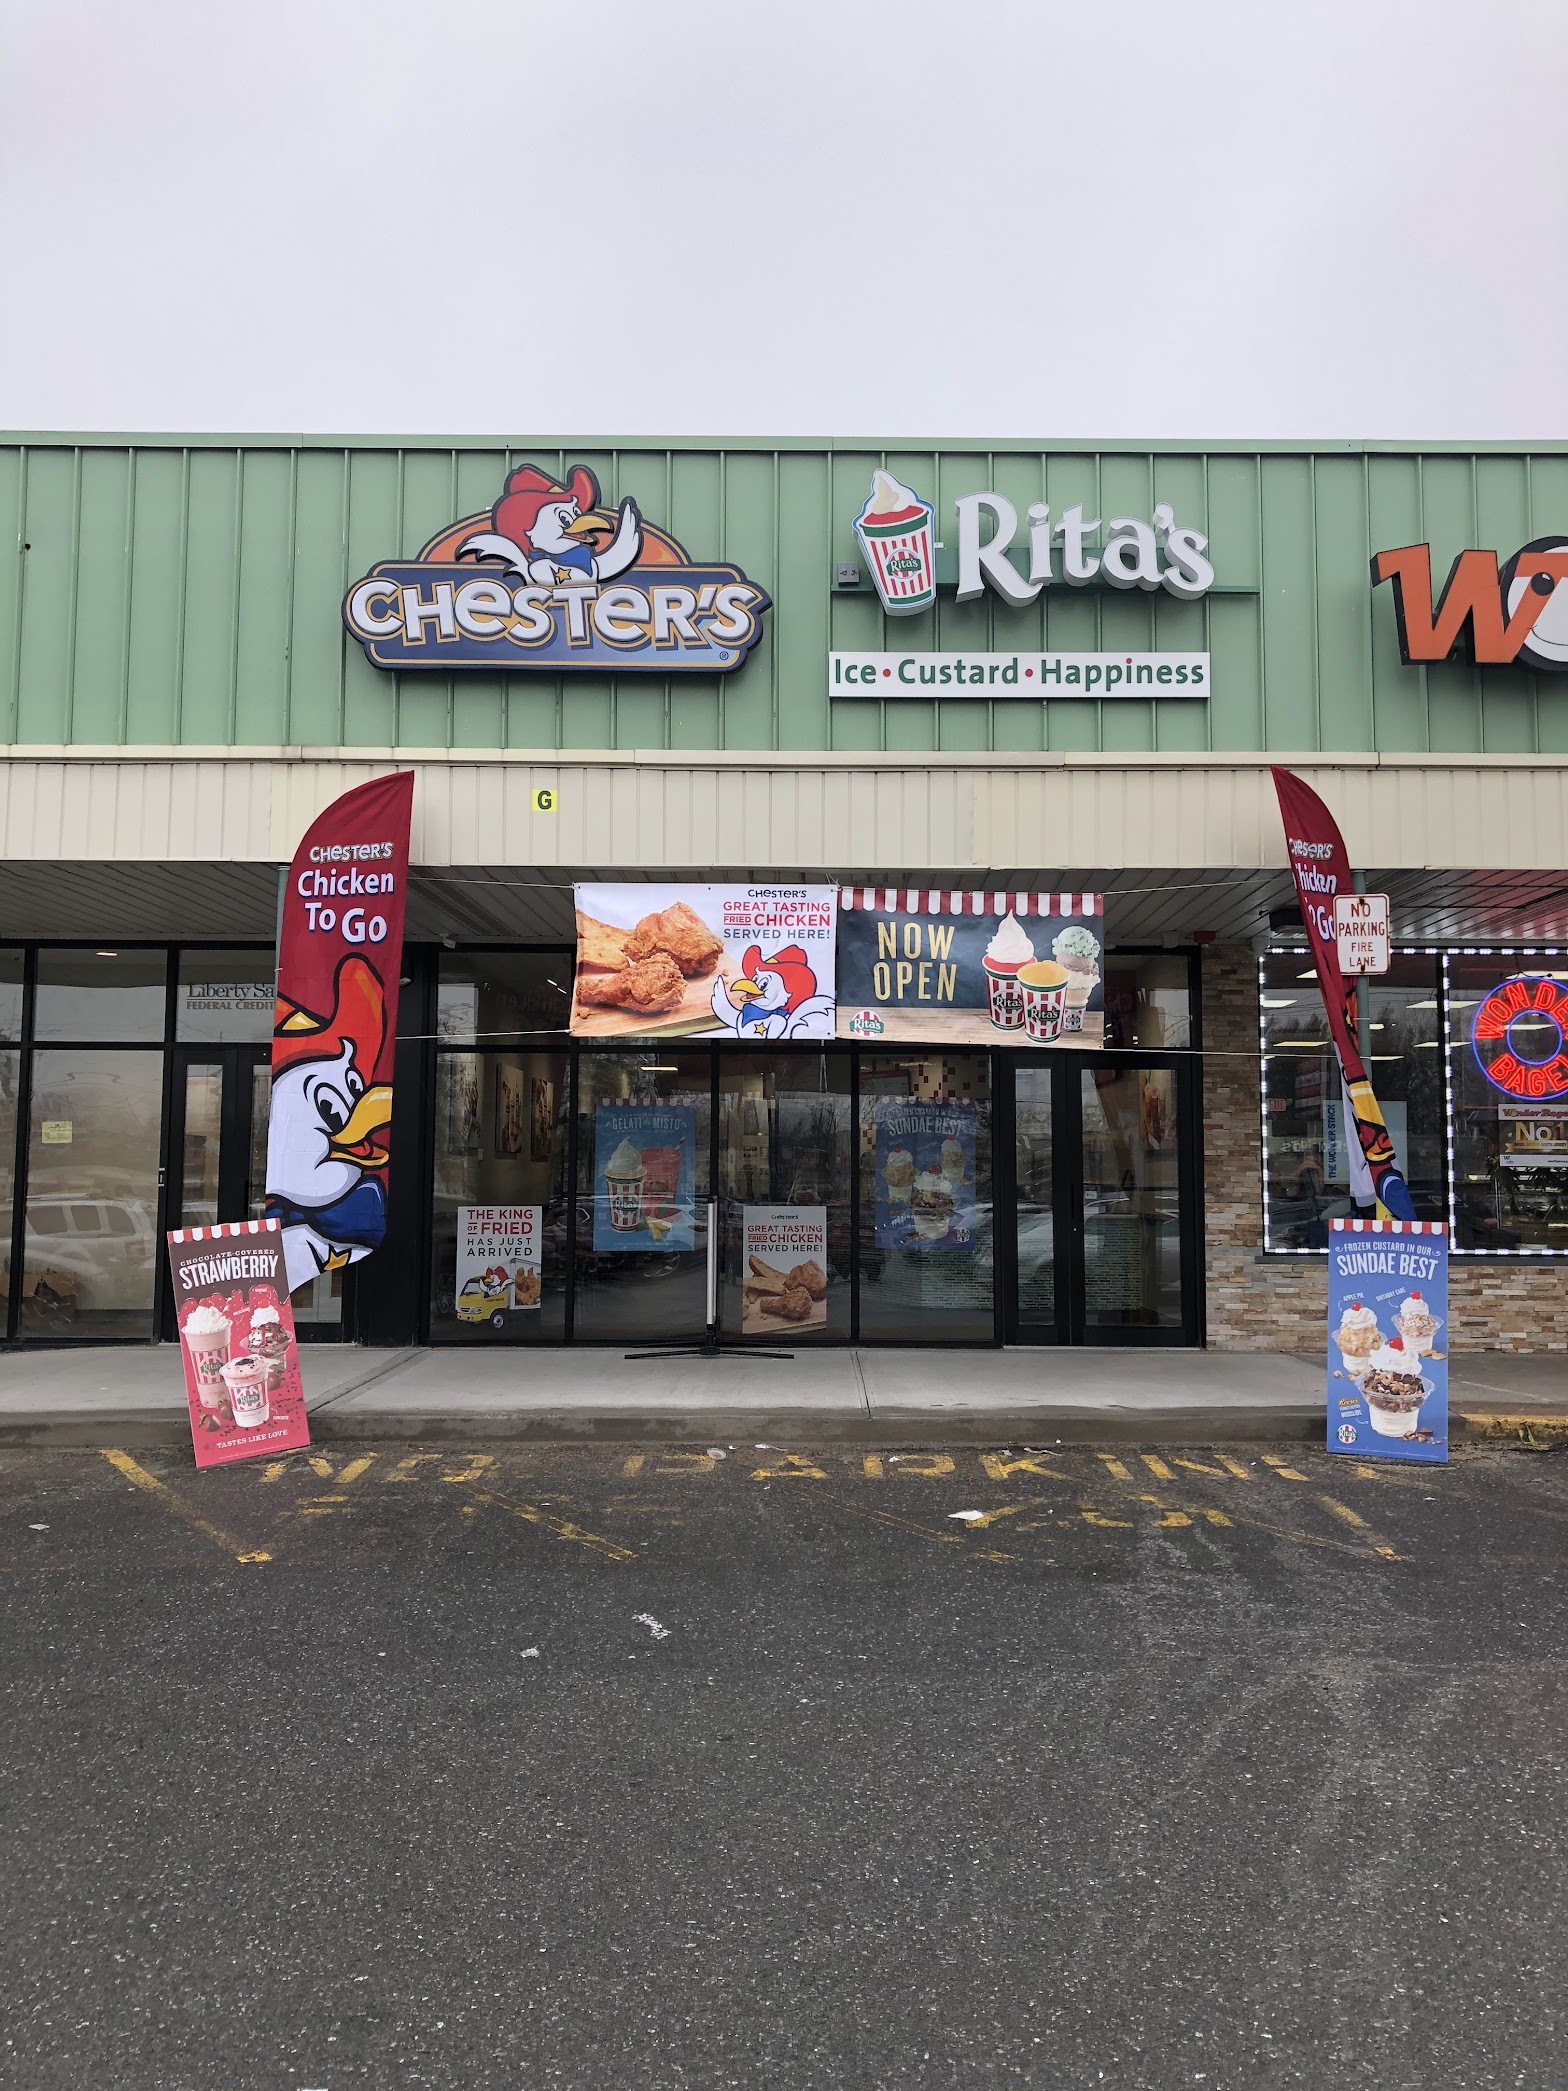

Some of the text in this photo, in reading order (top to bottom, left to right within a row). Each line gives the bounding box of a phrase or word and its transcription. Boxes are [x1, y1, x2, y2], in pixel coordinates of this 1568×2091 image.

[955, 491, 1214, 607] Rita's
[891, 558, 918, 571] Rita's
[835, 657, 1204, 692] Ice Custard Happiness
[537, 790, 552, 809] G
[298, 867, 394, 897] Chicken
[723, 902, 830, 913] GREAT TASTING
[1351, 903, 1371, 917] NO
[304, 902, 388, 944] To Go
[723, 914, 831, 927] FRIED CHICKEN
[723, 929, 830, 939] SERVED HERE!
[1338, 921, 1385, 936] PARKING
[877, 921, 955, 960] NOW
[1351, 942, 1374, 952] FIRE
[1349, 956, 1376, 967] LANE
[873, 961, 957, 1002] OPEN
[187, 983, 251, 1001] Liberty
[187, 1001, 275, 1010] FEDERAL CREDIT
[996, 997, 1022, 1008] Rita's
[1031, 1009, 1058, 1019] Rita's
[1475, 981, 1568, 1039] WONDE
[853, 1017, 881, 1031] Rita's
[1488, 1053, 1568, 1096] BAGE
[612, 1117, 642, 1130] GELATI
[652, 1117, 680, 1130] MISTO
[887, 1116, 964, 1136] SUNDAE BEST
[467, 1209, 533, 1220] THE KING
[481, 1222, 533, 1235] FRIED
[747, 1225, 823, 1233] GREAT TASTING
[467, 1237, 532, 1246] HAS JUST
[769, 1234, 823, 1243] CHICKEN
[467, 1247, 533, 1257] ARRIVED
[792, 1244, 823, 1252] HERE!
[1343, 1241, 1432, 1256] FROZEN CUSTARD IN OUR
[180, 1249, 275, 1267] CHOCOLATE-COVERED
[179, 1255, 279, 1290] STRAWBERRY
[1336, 1252, 1439, 1281] SUNDAE BEST
[240, 1395, 259, 1404] Rita's
[217, 1429, 288, 1449] TASTES LIKE LOVE
